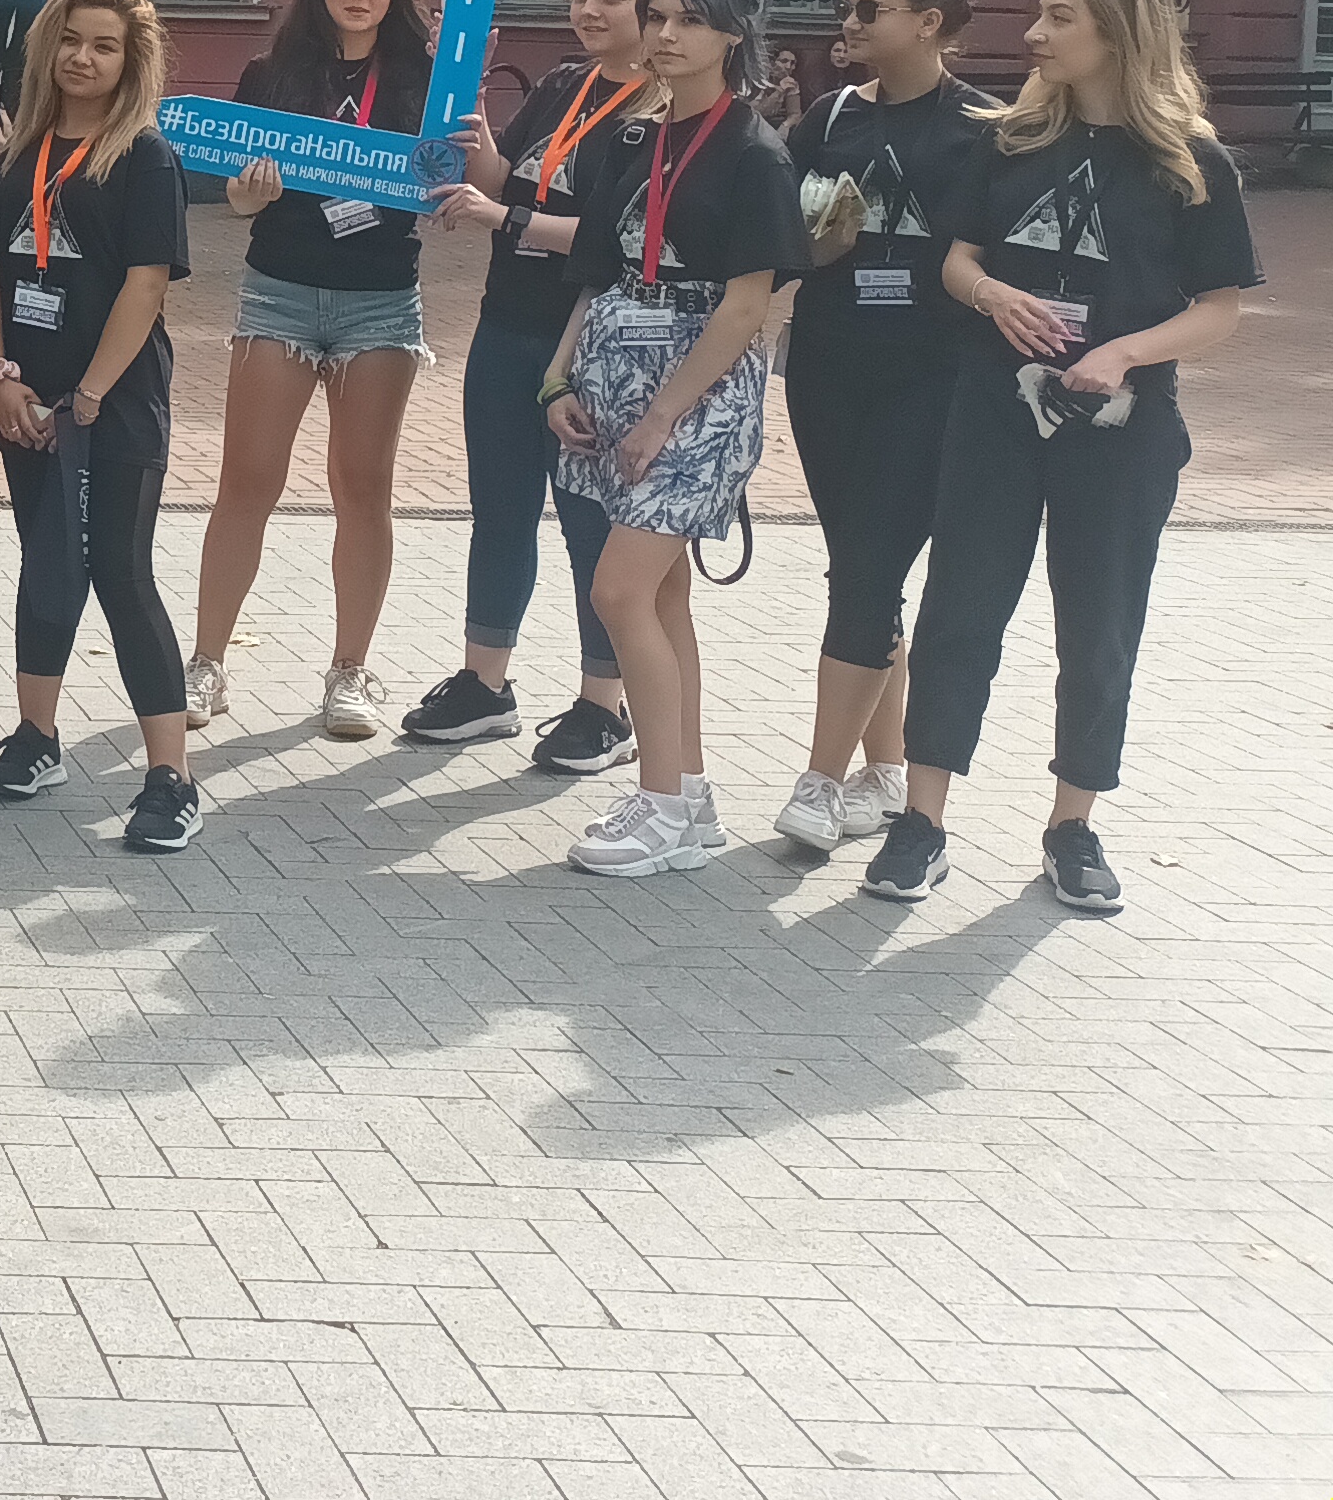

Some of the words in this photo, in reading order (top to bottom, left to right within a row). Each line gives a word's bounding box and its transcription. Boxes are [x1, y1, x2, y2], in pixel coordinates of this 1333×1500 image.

[188, 143, 221, 163] СЛЕД
[281, 163, 297, 177] НА
[299, 167, 372, 190] НАРКОТИЧНИ
[373, 180, 430, 201] ВЕЩЕСТВ
